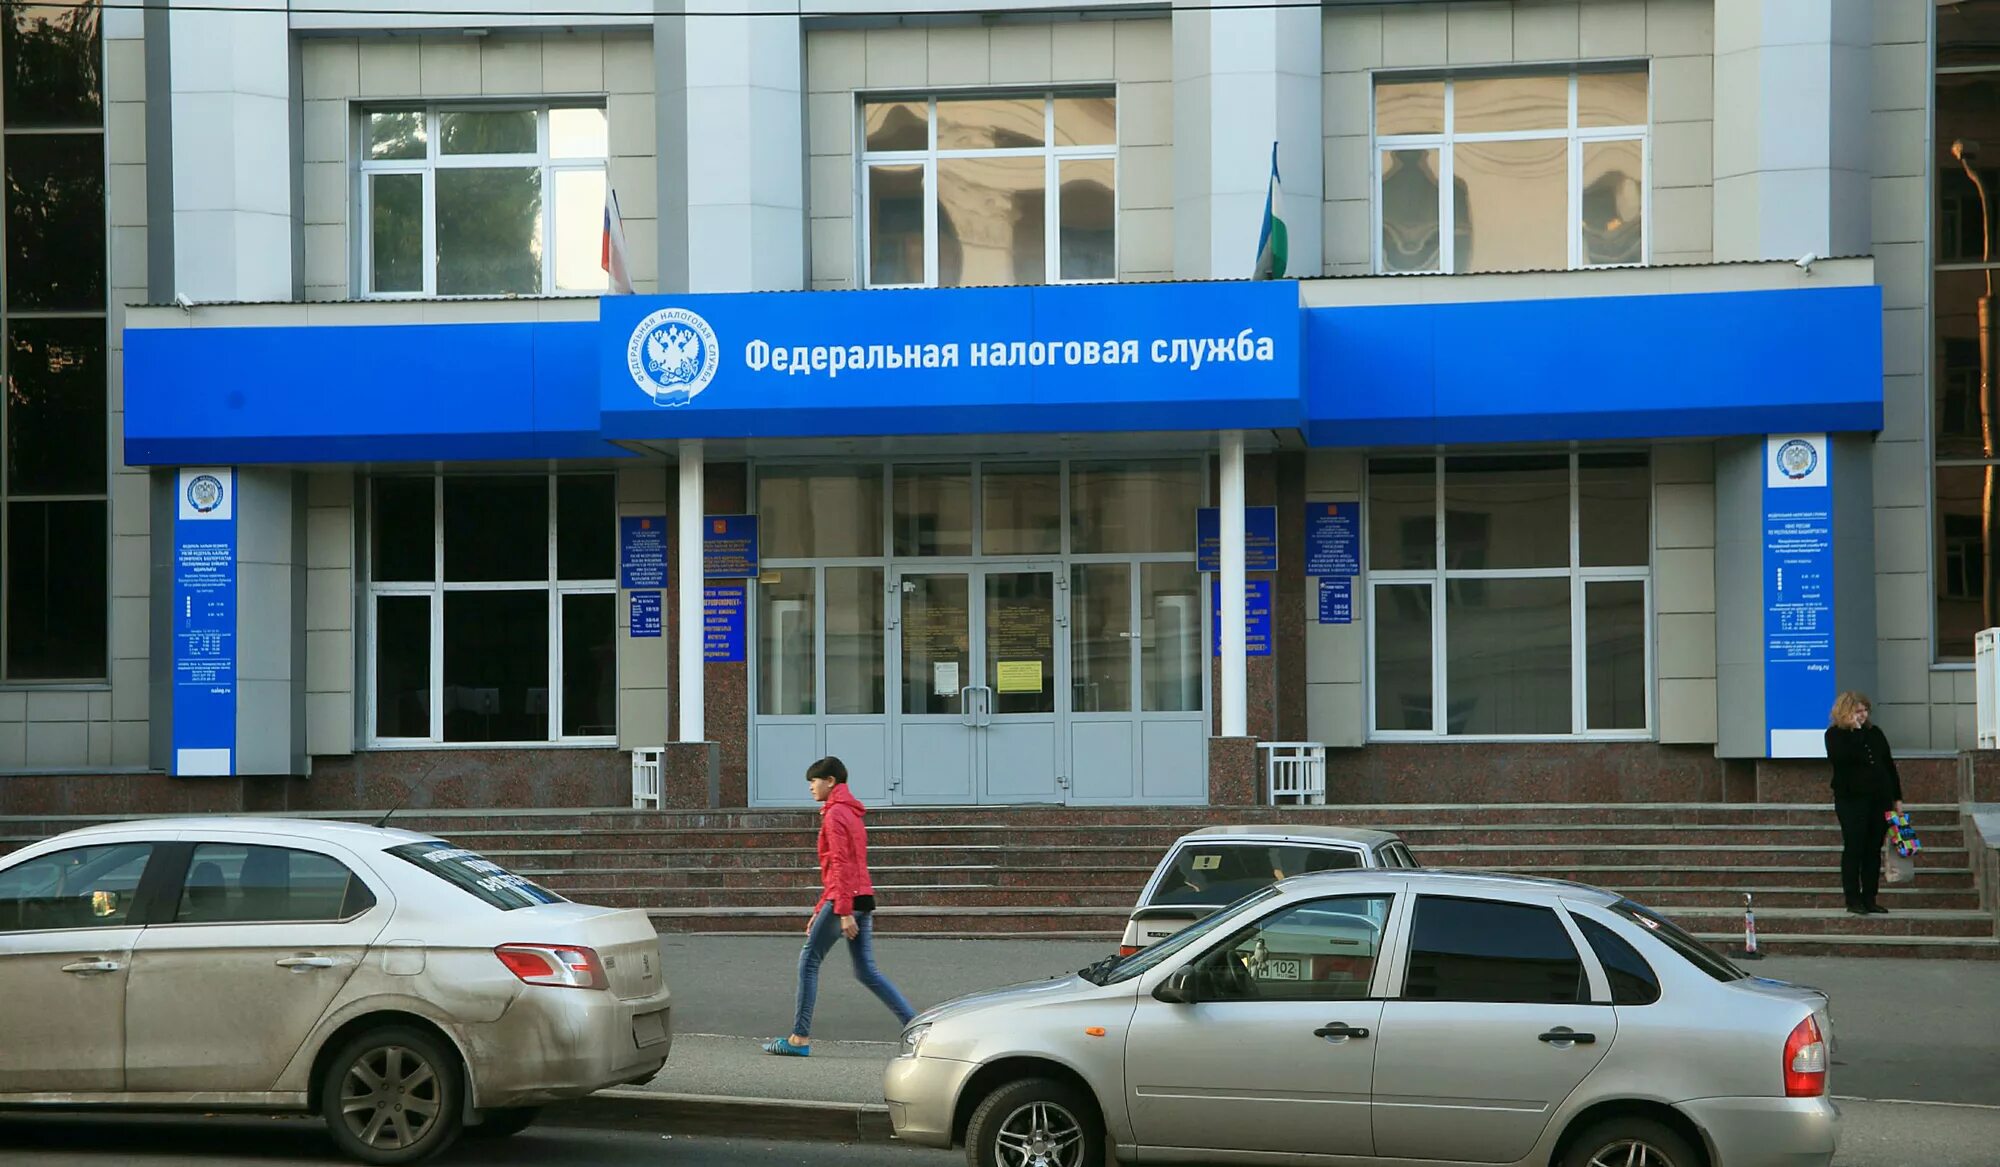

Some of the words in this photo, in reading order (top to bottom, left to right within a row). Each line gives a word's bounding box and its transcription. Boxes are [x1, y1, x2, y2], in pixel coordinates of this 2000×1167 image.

[631, 318, 656, 382] ФЕДЕРАЛЬНАЯ
[660, 312, 711, 339] НАЛОГОВАЯ
[701, 344, 717, 383] СЛУЖБА
[746, 340, 958, 377] Федеральная
[971, 341, 1138, 366] налоговая
[1152, 328, 1273, 370] служба
[1273, 961, 1295, 974] 102
